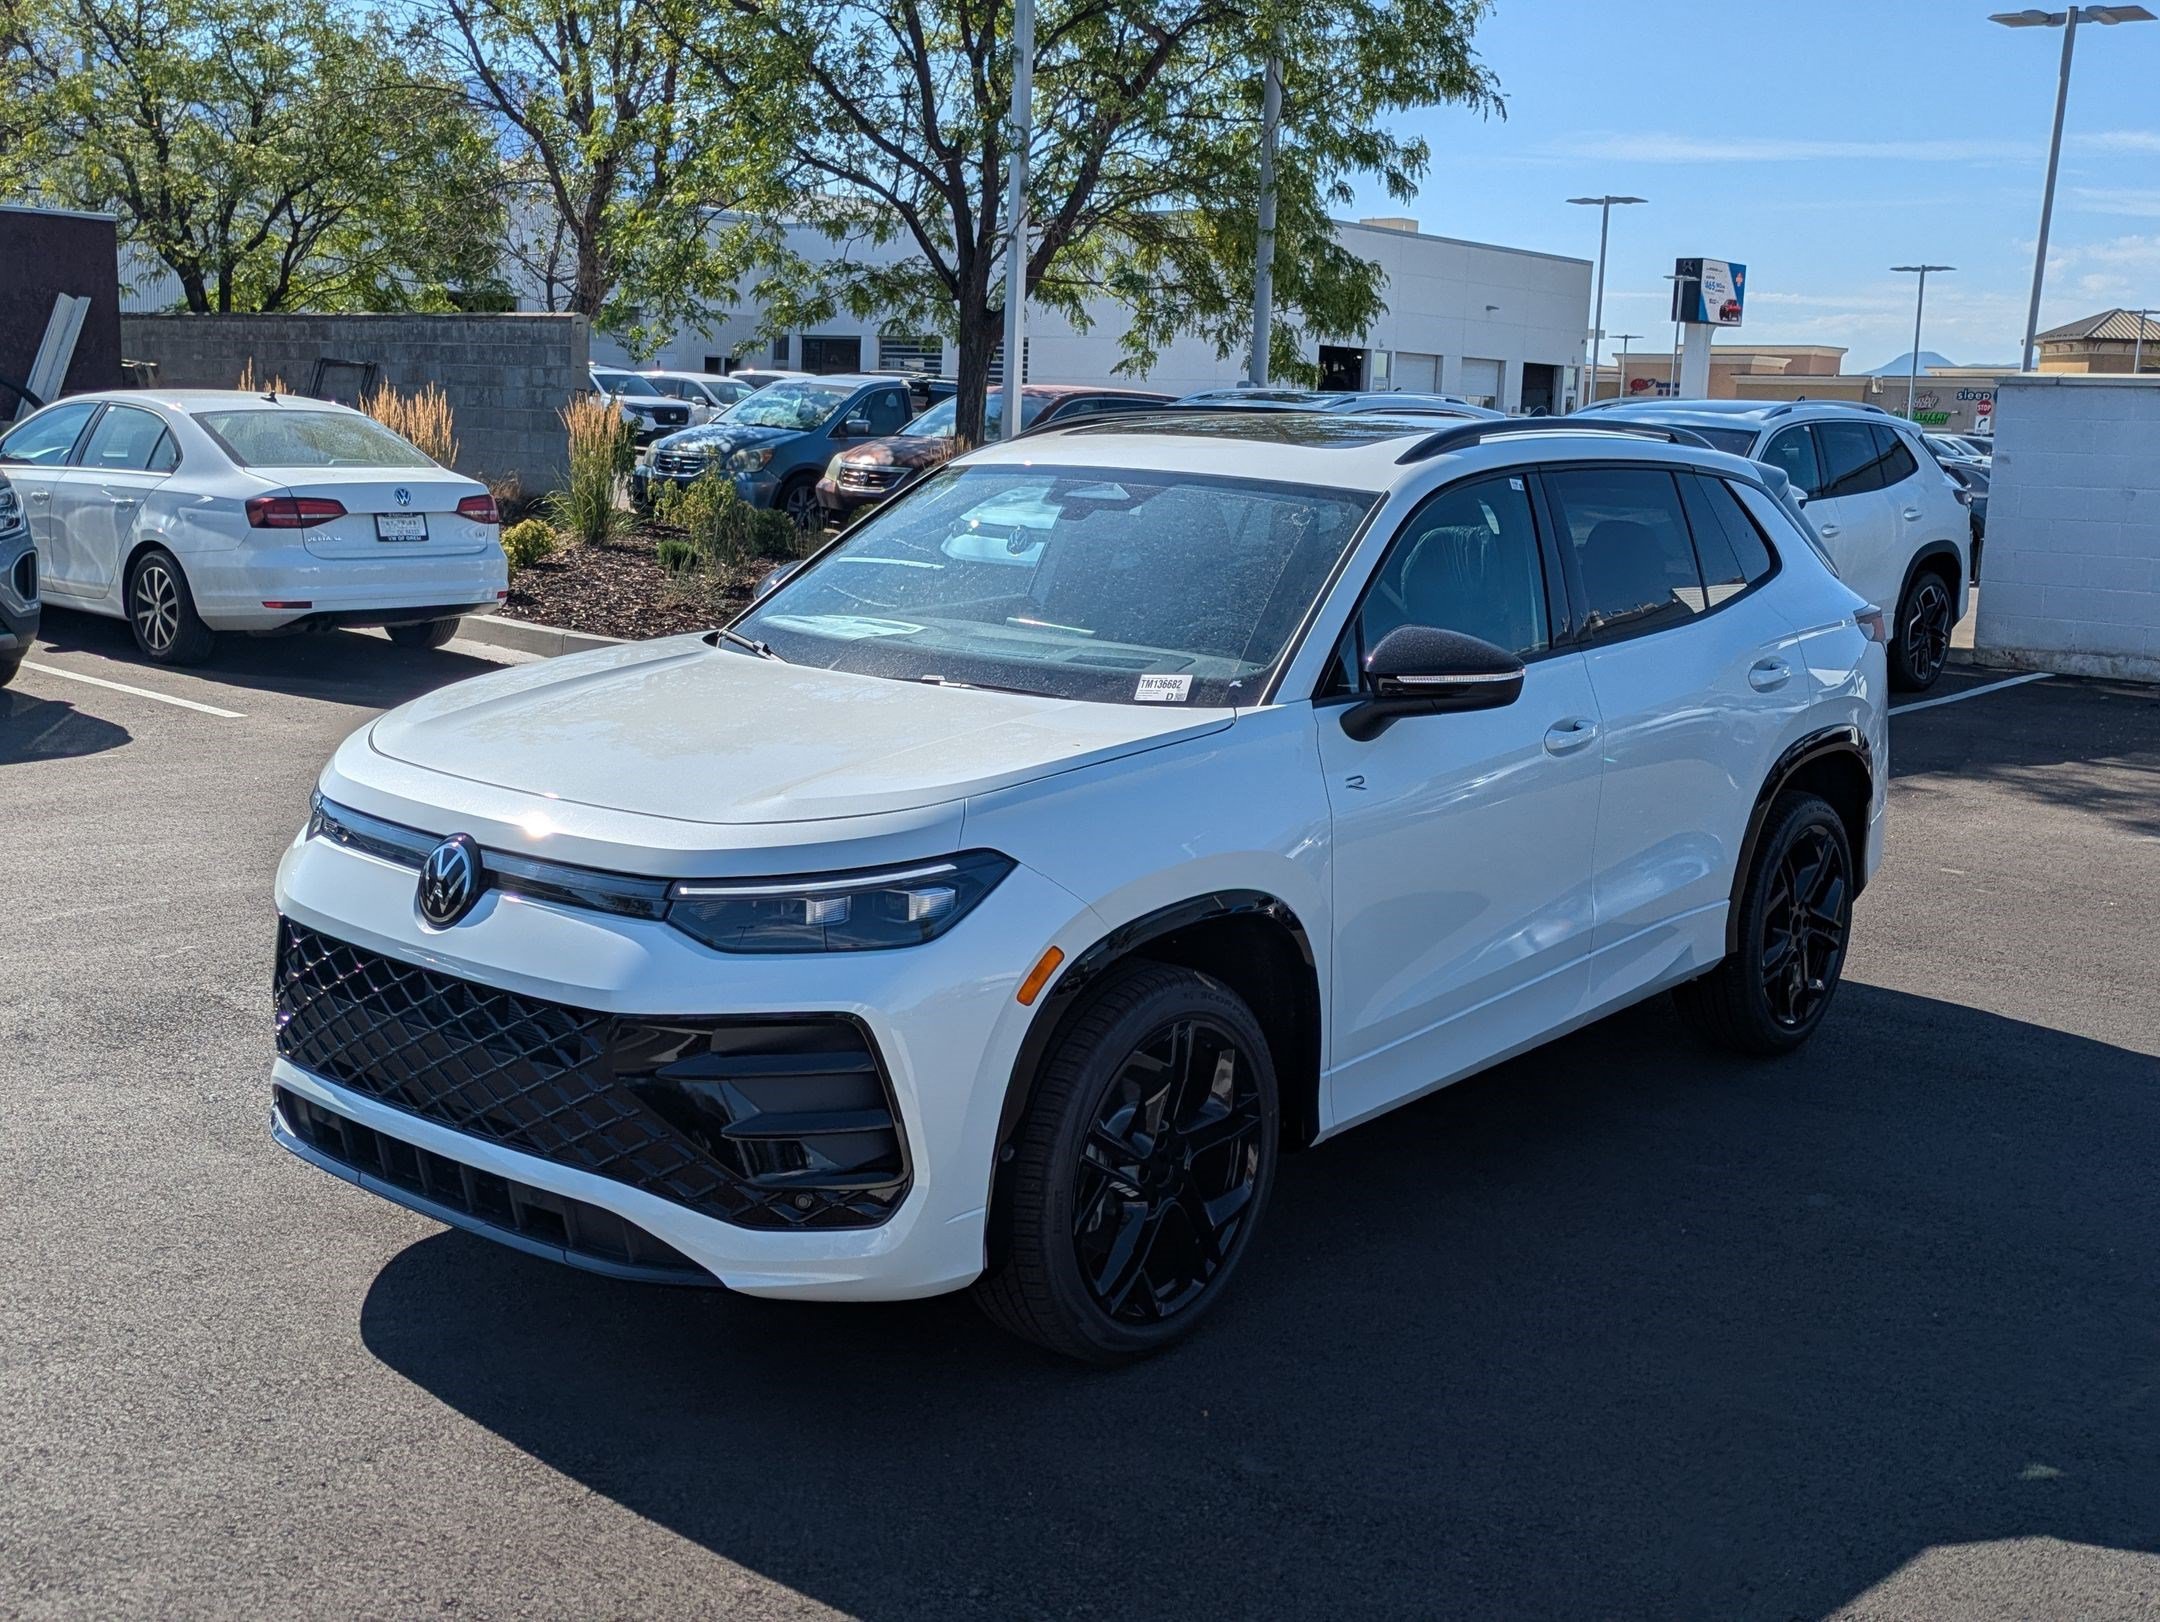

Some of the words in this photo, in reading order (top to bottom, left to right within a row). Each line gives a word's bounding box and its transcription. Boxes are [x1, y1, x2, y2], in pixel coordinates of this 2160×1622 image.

[1957, 388, 1991, 400] sleep
[1141, 679, 1183, 689] TM136682
[1166, 692, 1174, 701] D
